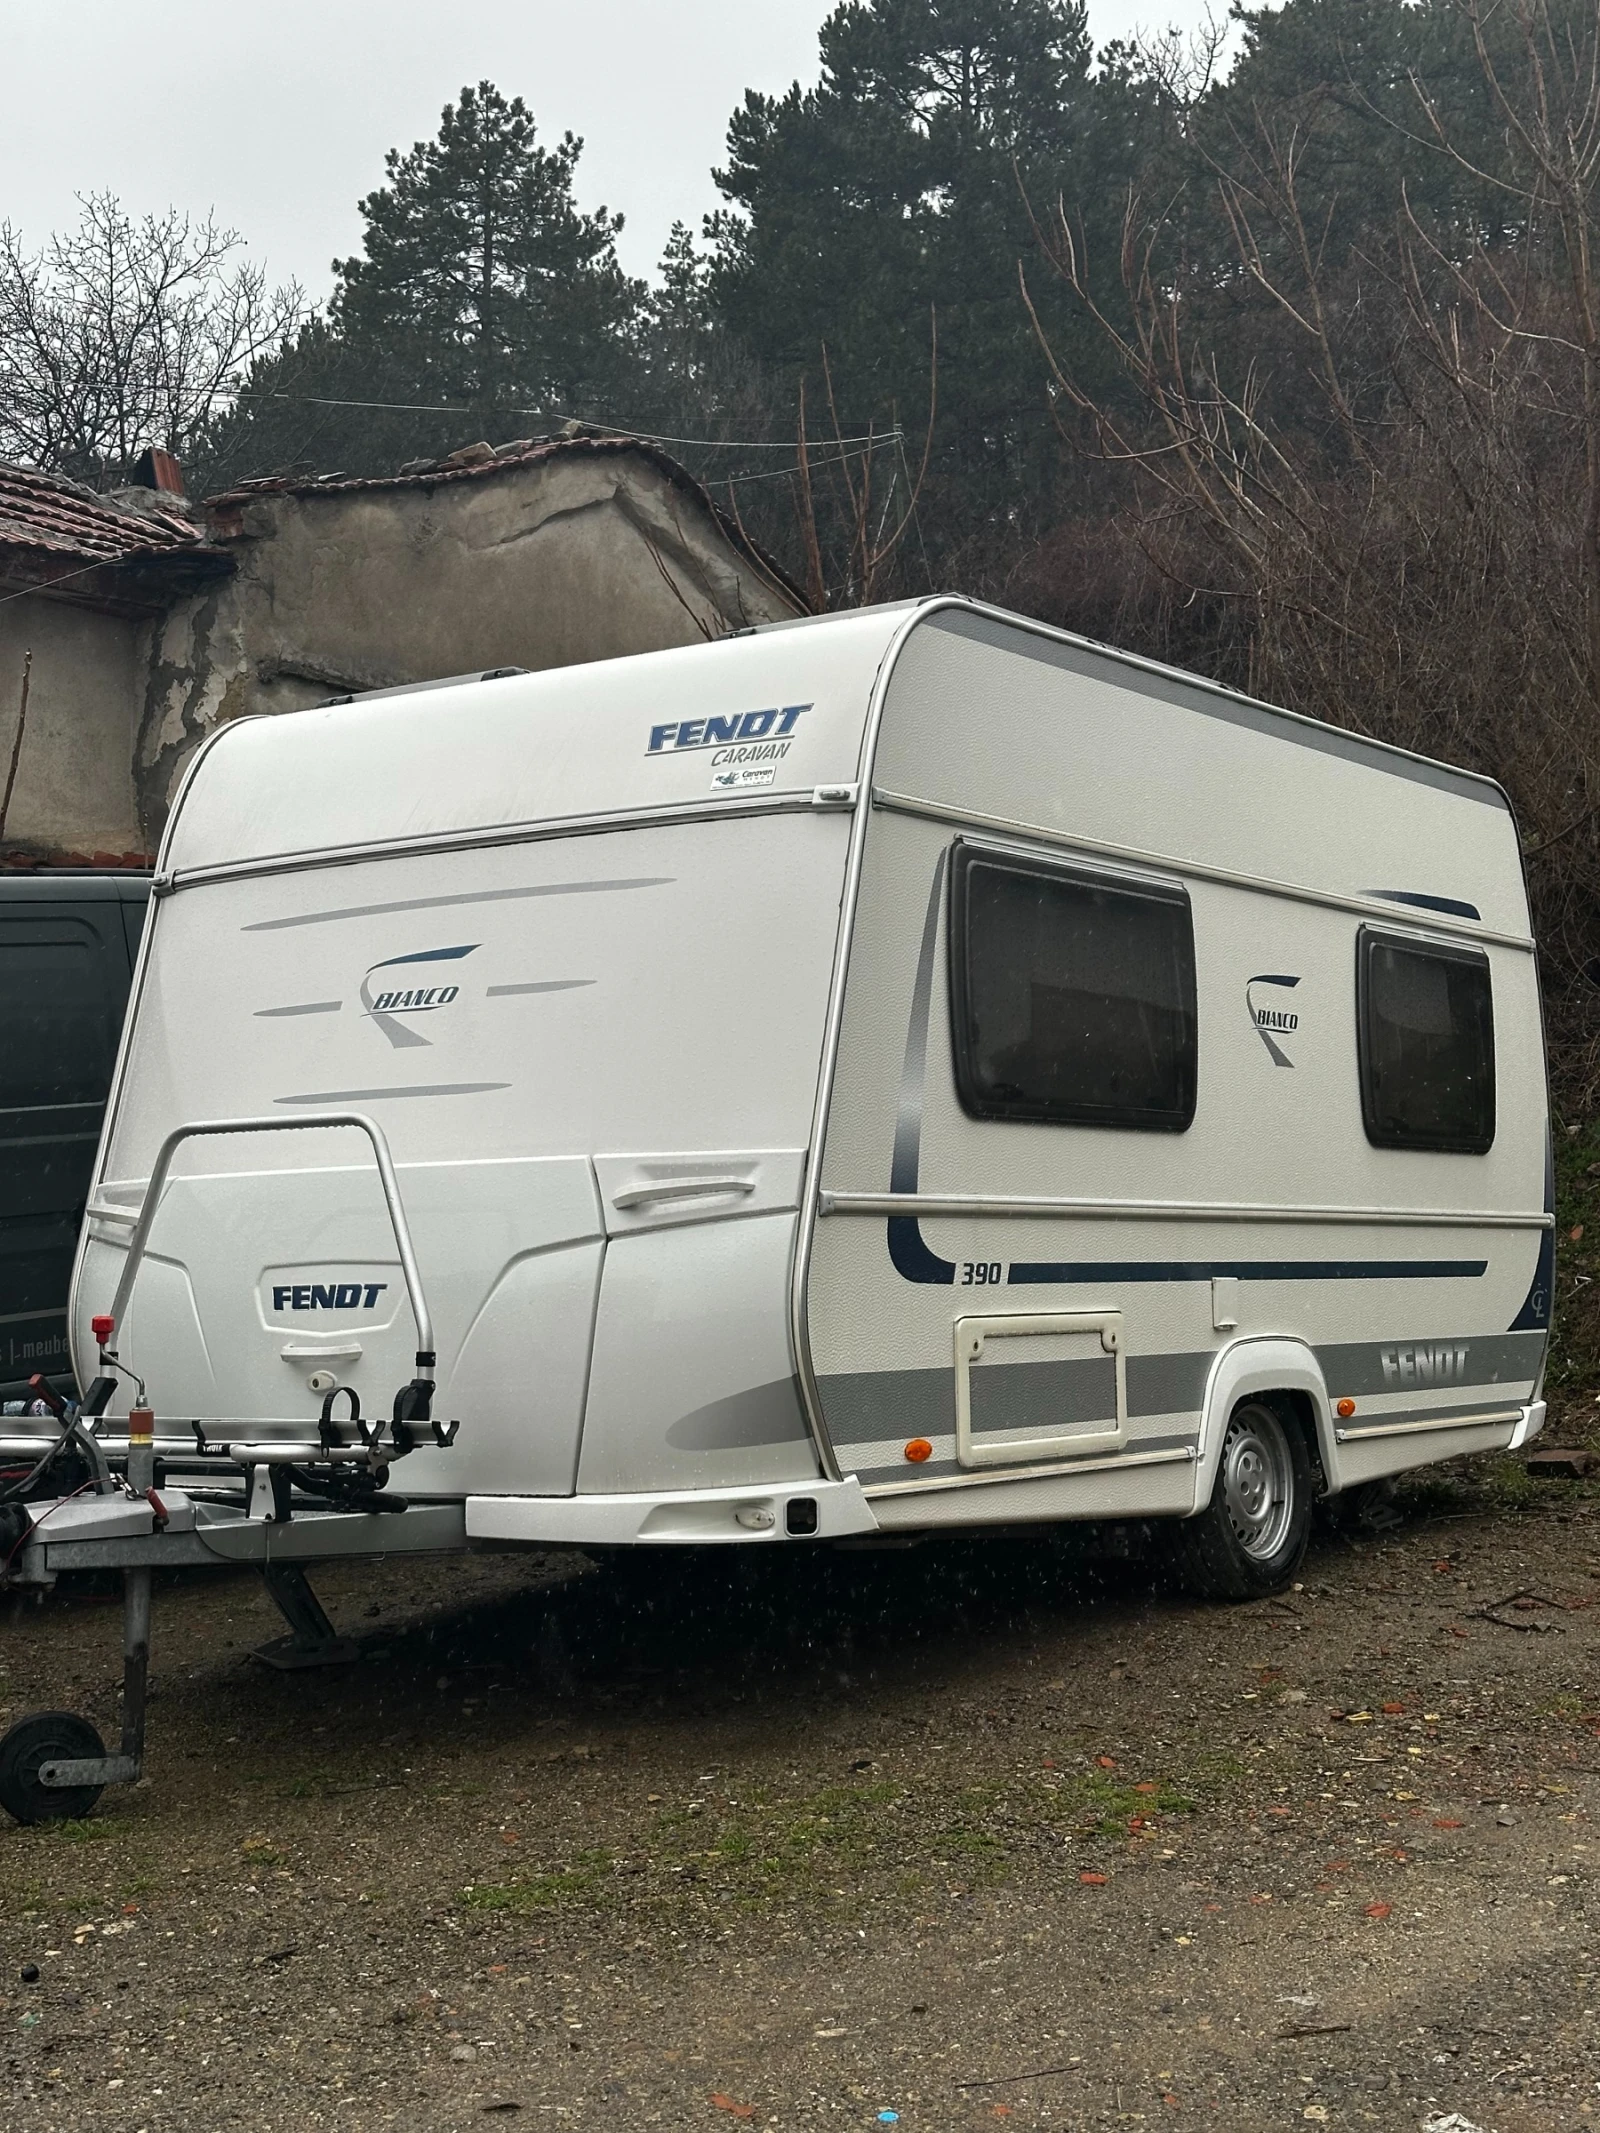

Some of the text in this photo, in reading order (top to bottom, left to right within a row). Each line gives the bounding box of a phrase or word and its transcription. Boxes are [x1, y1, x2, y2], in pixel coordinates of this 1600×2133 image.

[647, 702, 815, 752] FENDT
[710, 742, 792, 767] CARAVAN
[742, 769, 773, 778] Caravan
[372, 986, 460, 1010] BIANCO
[1257, 1009, 1299, 1030] BIANCO
[961, 1262, 1002, 1286] 390
[272, 1283, 388, 1311] FENDT
[1379, 1342, 1470, 1384] FENDT
